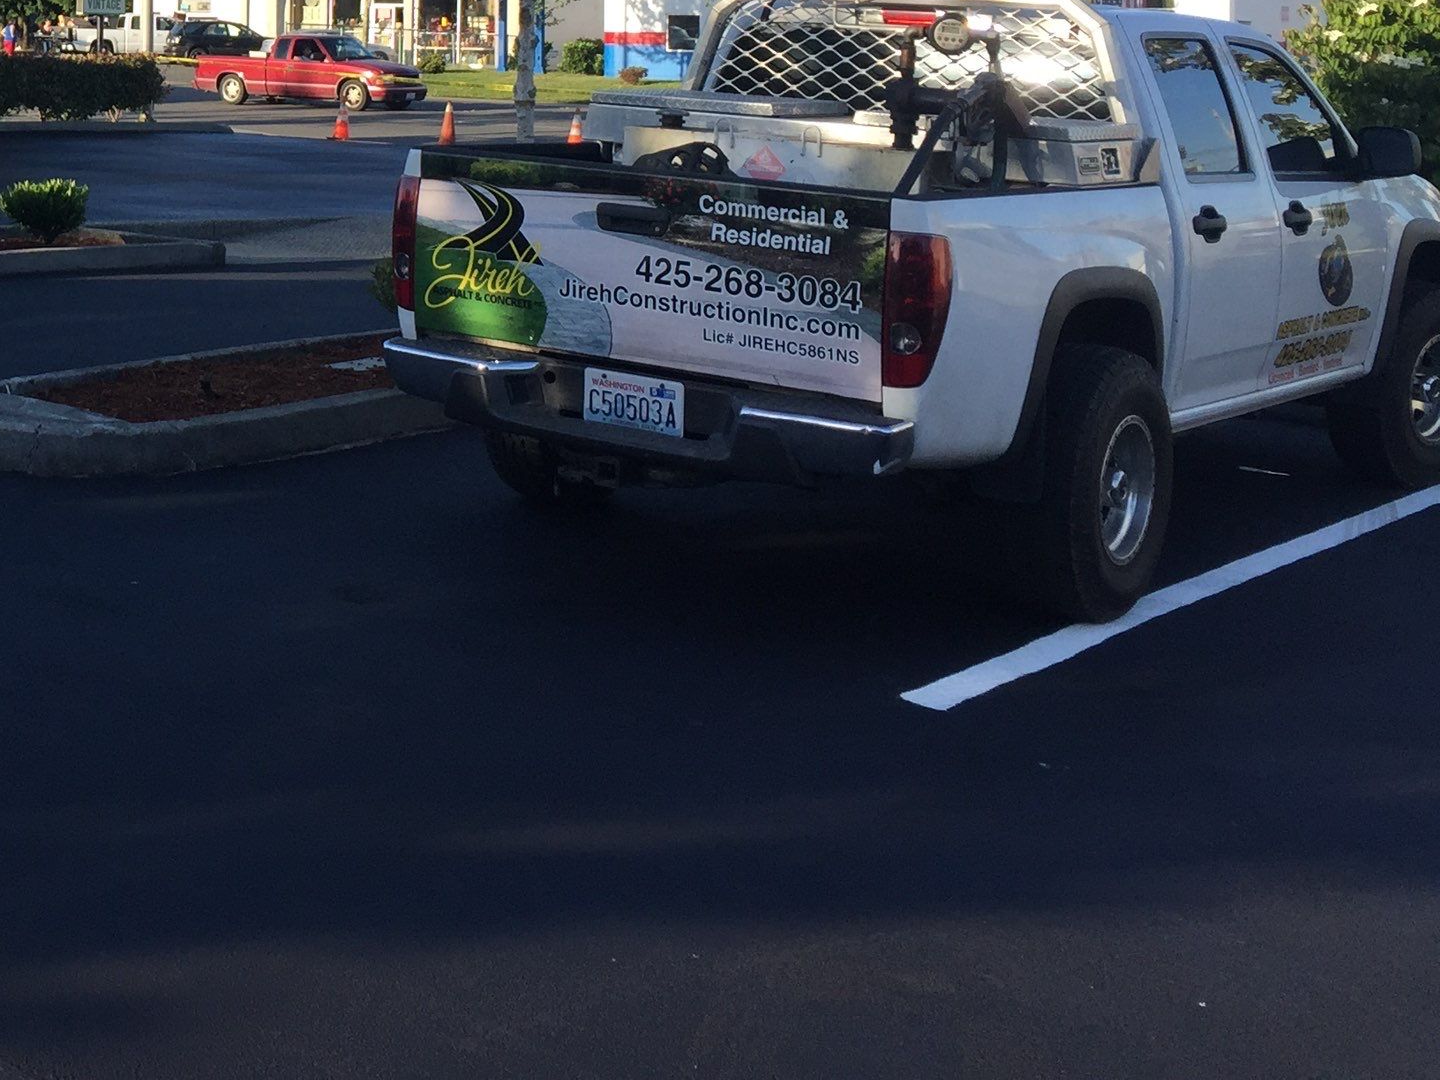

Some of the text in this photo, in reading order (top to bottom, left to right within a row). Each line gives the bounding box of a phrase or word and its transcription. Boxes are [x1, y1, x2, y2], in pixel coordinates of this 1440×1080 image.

[698, 194, 849, 230] Commercial &
[711, 222, 831, 255] Residential
[425, 235, 541, 308] Jireh
[635, 255, 862, 312] 425-268-3084
[474, 292, 483, 301] &
[484, 293, 533, 309] CONCRETE
[559, 278, 860, 340] JirehConstructionInc.com
[703, 328, 859, 364] Lic# JIREHC5861NS
[591, 378, 646, 393] WASHINGTON
[589, 388, 676, 429] C50503A
